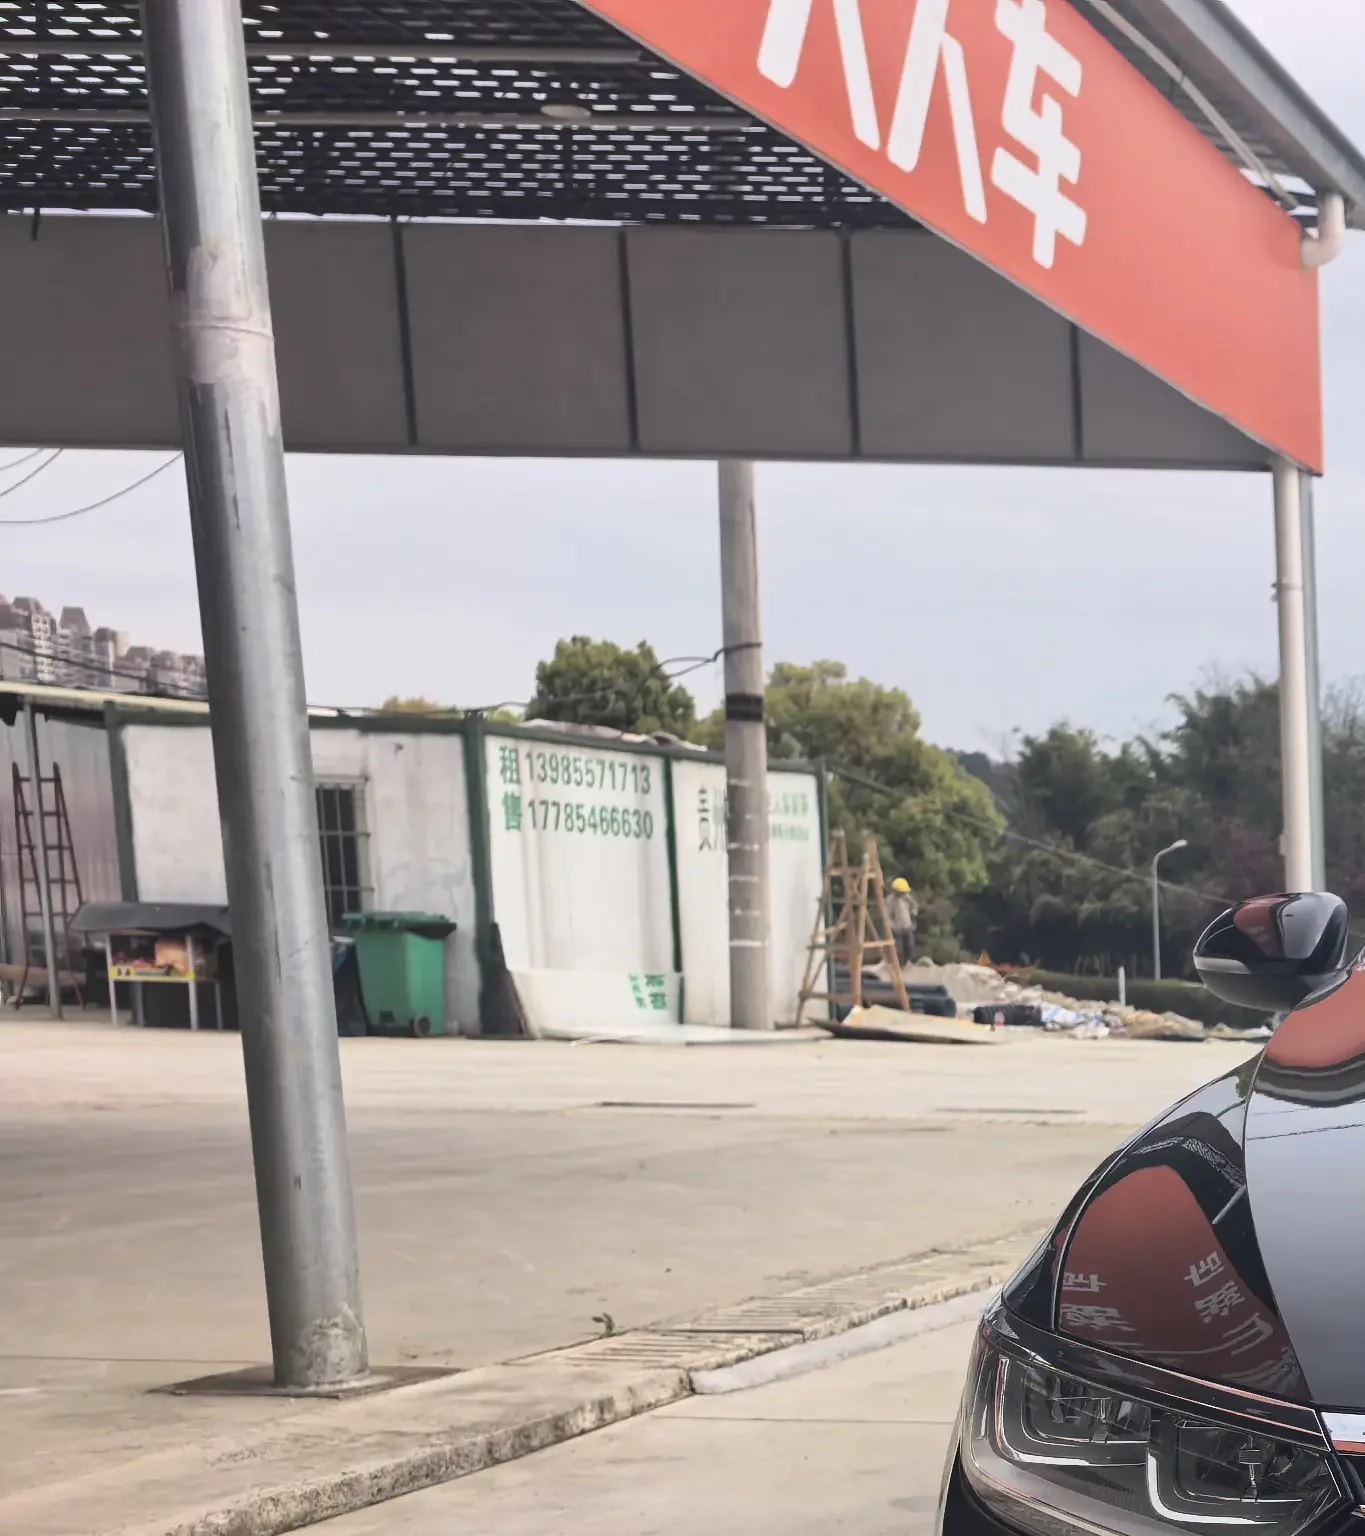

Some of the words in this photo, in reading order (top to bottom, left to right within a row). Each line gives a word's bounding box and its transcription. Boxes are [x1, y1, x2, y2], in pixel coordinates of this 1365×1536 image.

[499, 746, 520, 784] 租
[525, 752, 651, 795] 13985571713
[528, 799, 654, 840] 17785466630
